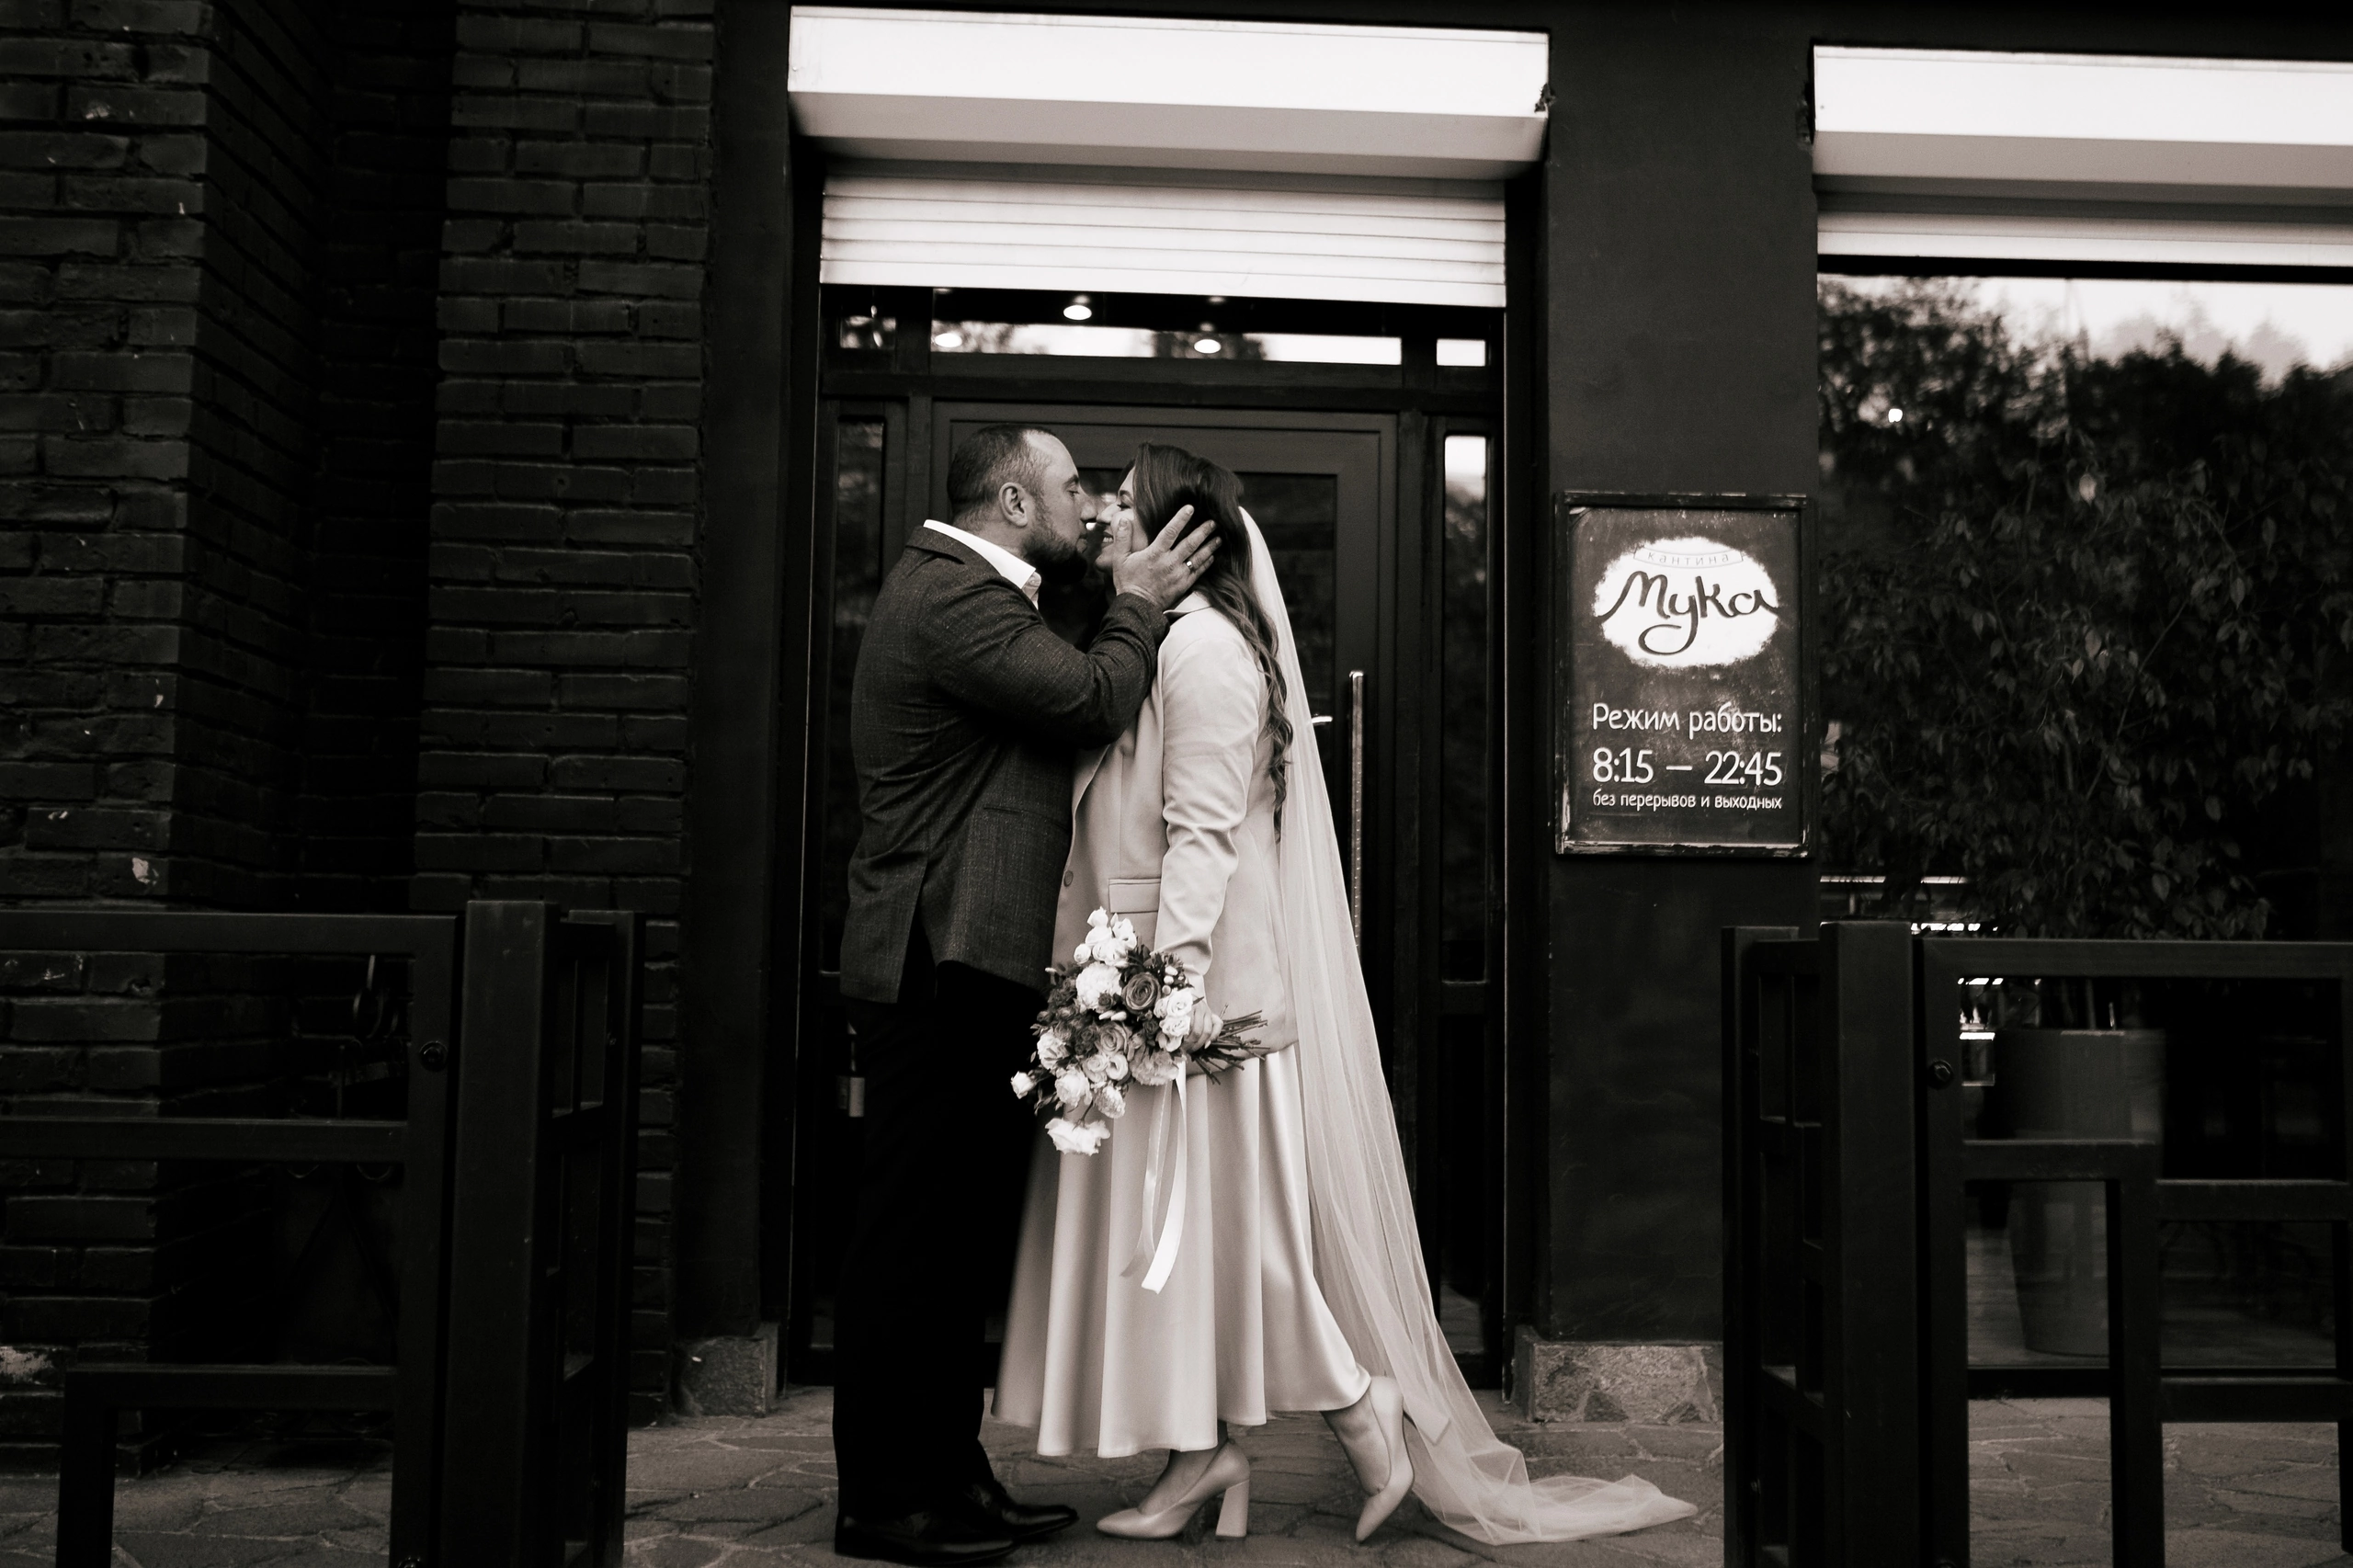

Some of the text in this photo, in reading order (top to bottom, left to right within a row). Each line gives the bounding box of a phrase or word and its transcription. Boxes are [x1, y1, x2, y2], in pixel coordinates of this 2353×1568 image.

[1648, 551, 1729, 566] кантина
[1597, 570, 1780, 656] Мука
[1593, 701, 1782, 740] Режим работы:
[1593, 746, 1654, 783] 8:15
[1704, 750, 1782, 786] 22:45
[1593, 789, 1782, 812] без перерывов и выходных
